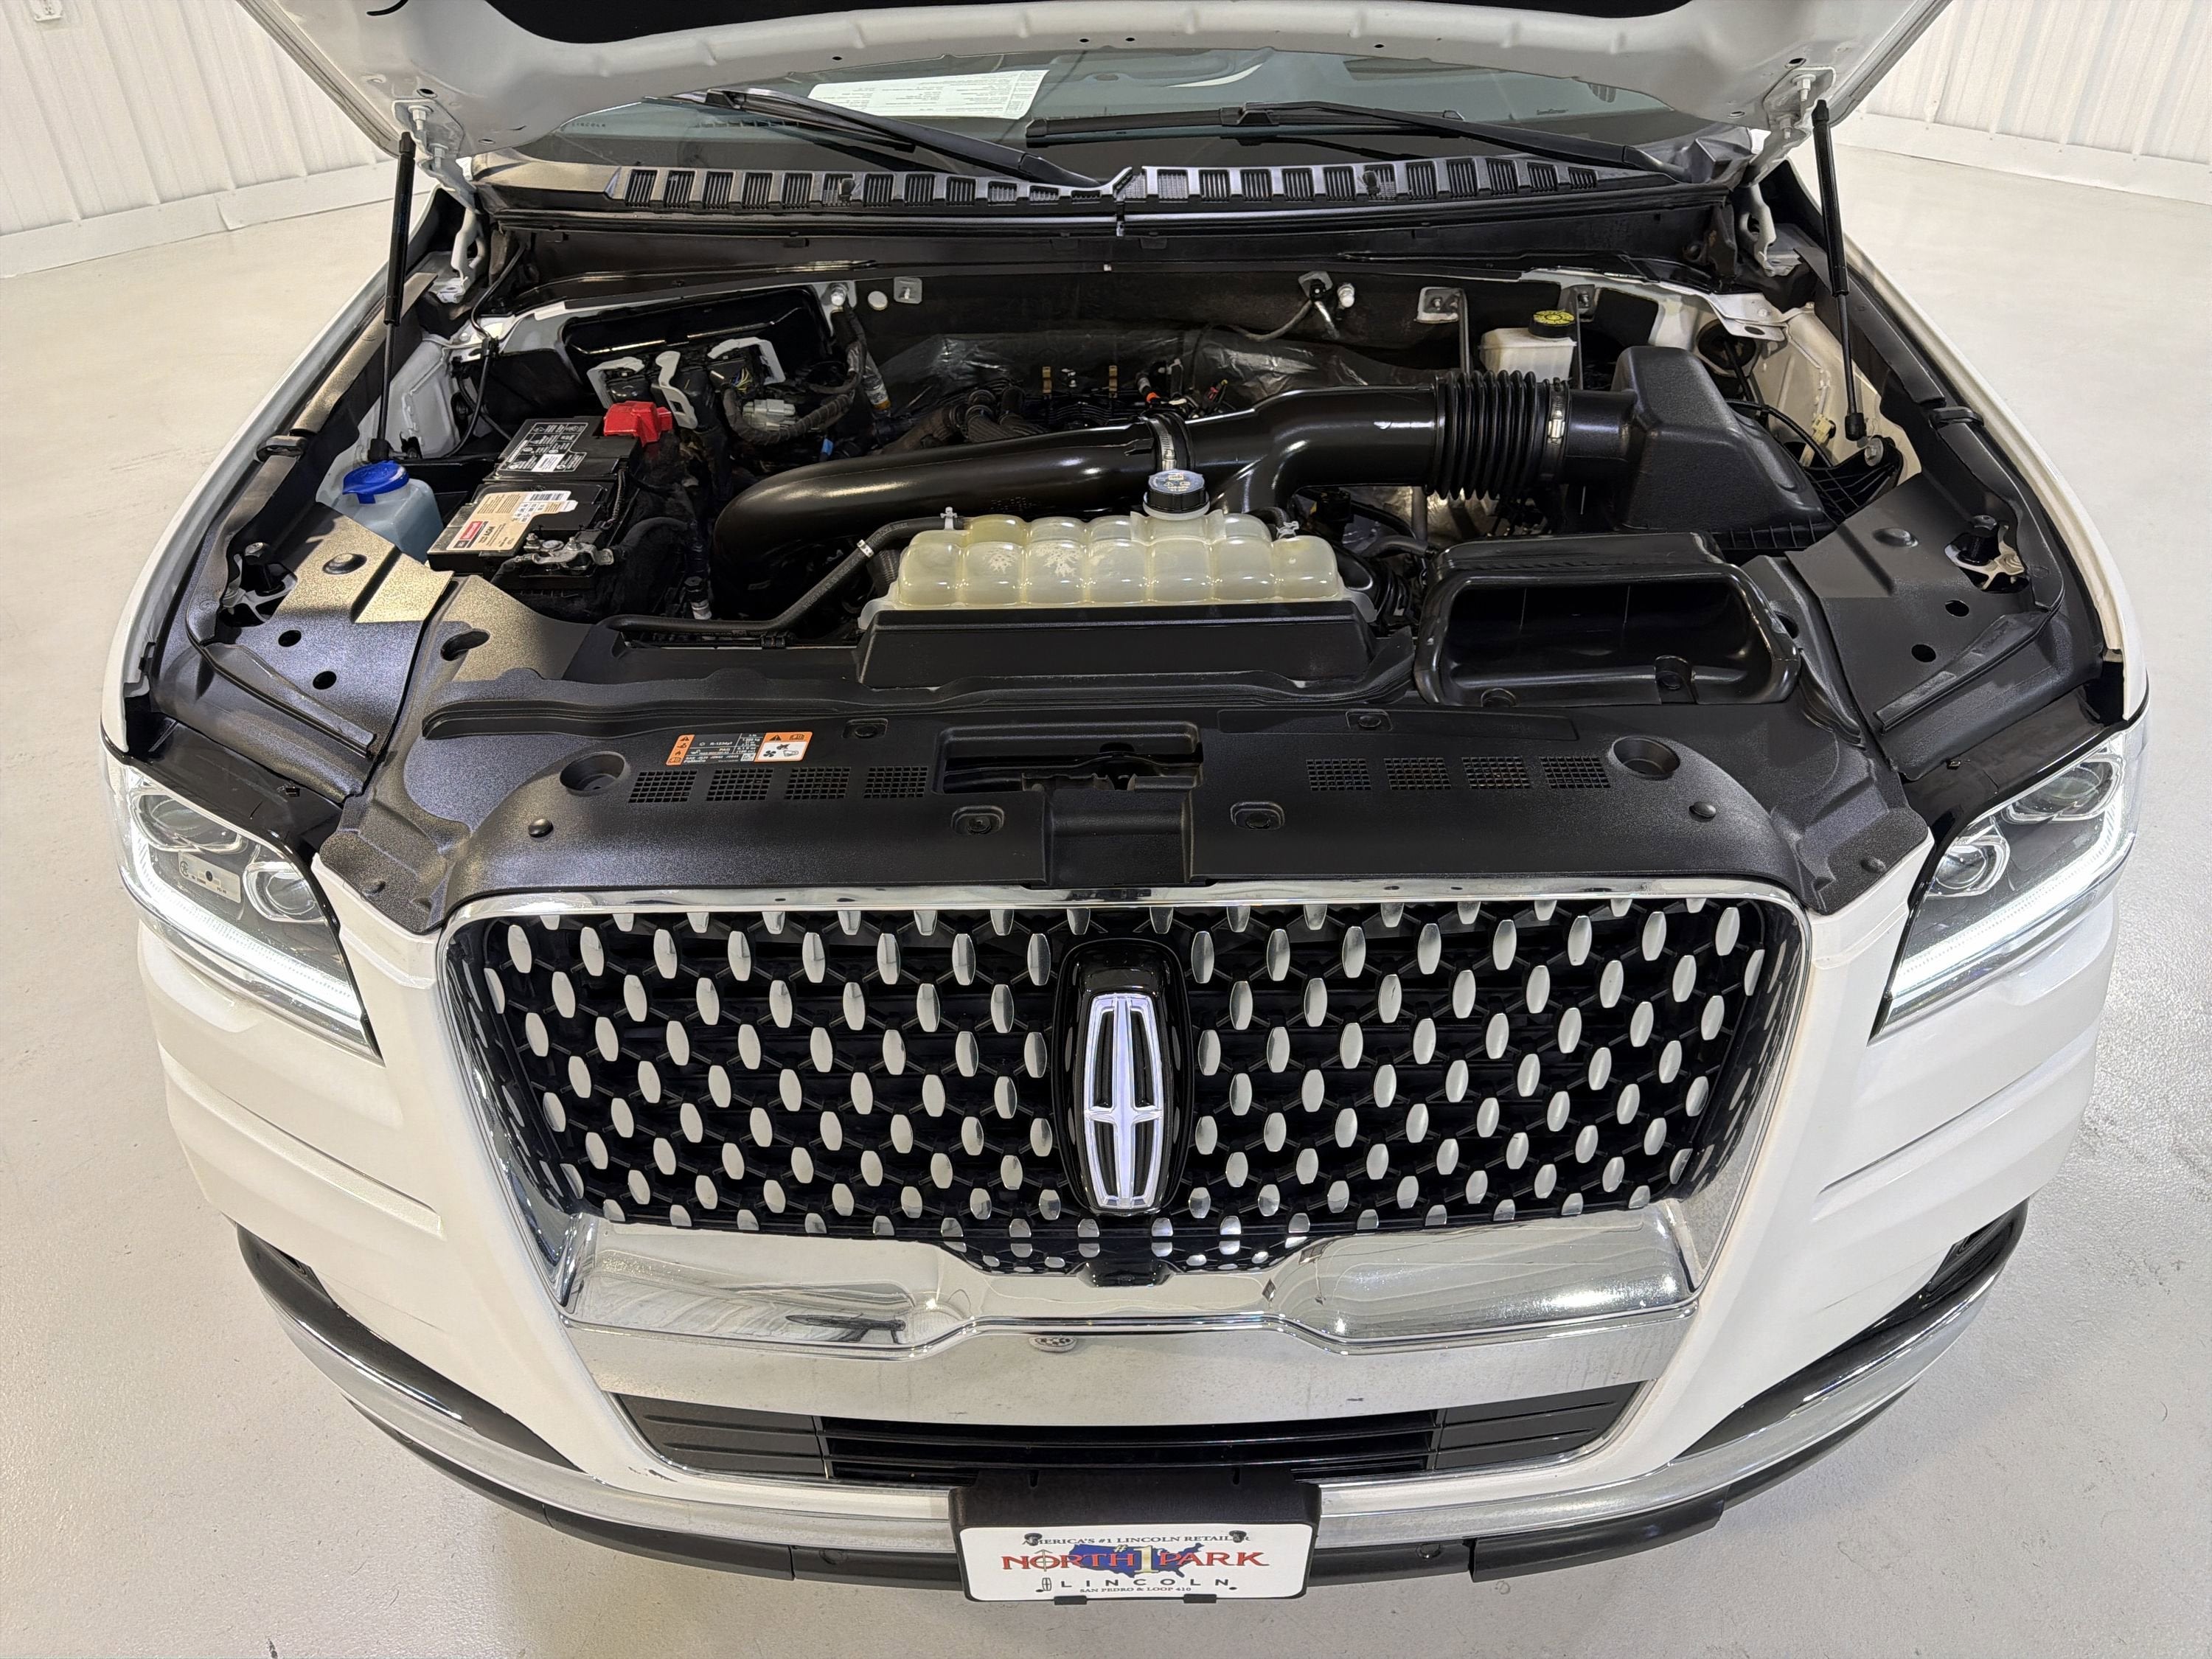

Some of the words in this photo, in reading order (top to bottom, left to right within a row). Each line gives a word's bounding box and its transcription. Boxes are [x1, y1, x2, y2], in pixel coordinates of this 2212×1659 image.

[1001, 1552, 1136, 1570] NORTH
[1159, 1551, 1270, 1567] PARK
[1060, 1579, 1229, 1587] LINCOLN
